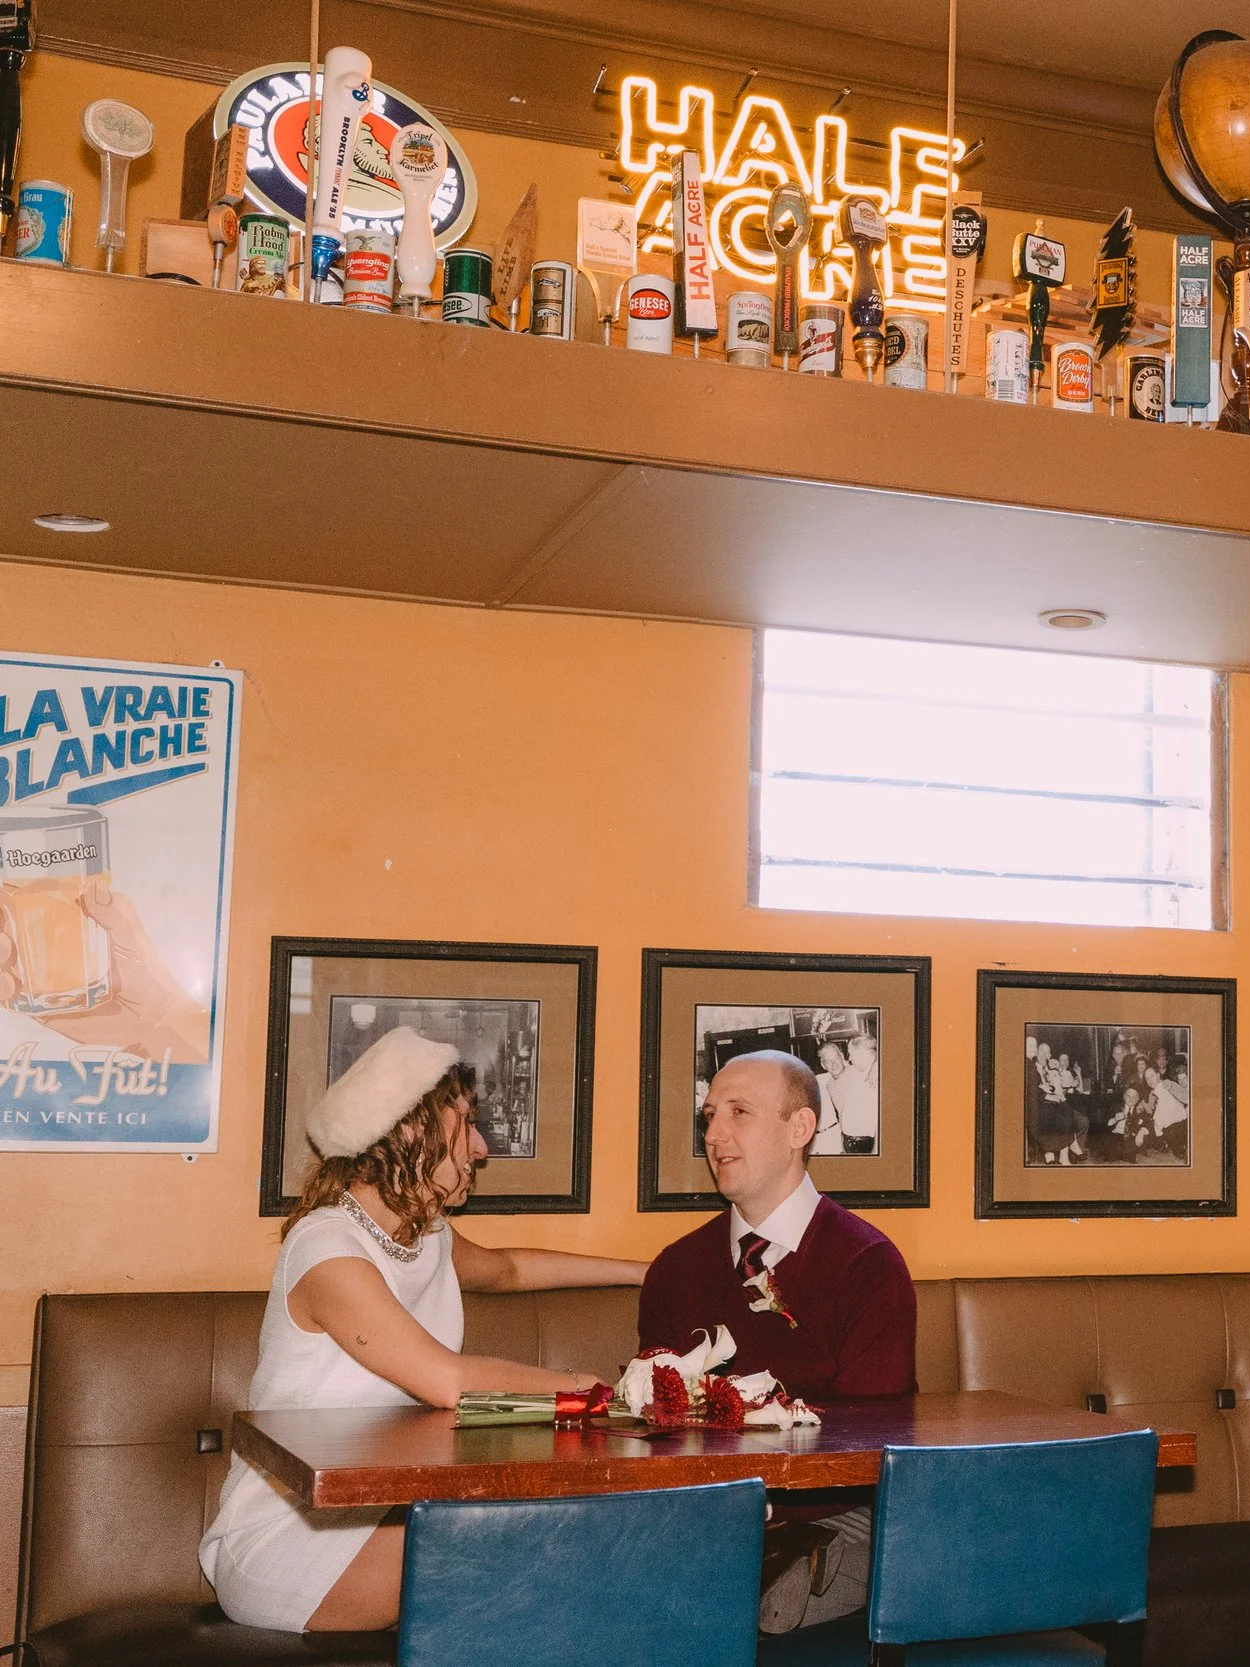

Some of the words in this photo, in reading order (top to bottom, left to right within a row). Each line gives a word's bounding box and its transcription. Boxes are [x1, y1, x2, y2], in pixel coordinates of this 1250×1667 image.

[337, 117, 351, 167] BROOKLYN
[406, 130, 433, 141] Tripel
[621, 75, 966, 208] HALF
[399, 158, 438, 172] Karmeliet
[330, 187, 340, 203] ALE
[688, 180, 704, 227] ACRE
[252, 224, 286, 241] Robin
[252, 236, 284, 252] Hood
[1180, 246, 1209, 256] HALF
[346, 258, 391, 271] Yuengling
[688, 233, 711, 300] HALF
[1180, 255, 1209, 265] ACRE
[629, 297, 669, 312] GENESEE
[951, 267, 966, 366] DESCHUTES
[1182, 309, 1206, 317] HALF
[1182, 316, 1206, 324] ACRE
[1058, 357, 1091, 373] Brown
[1062, 371, 1090, 389] Derby
[0, 689, 68, 747] LA
[81, 685, 210, 727] VRAIE
[7, 844, 97, 868] Hoegaarden
[0, 1042, 62, 1099] Au
[4, 1111, 30, 1123] EN
[39, 1111, 108, 1124] VENTE
[117, 1112, 147, 1125] ICI
